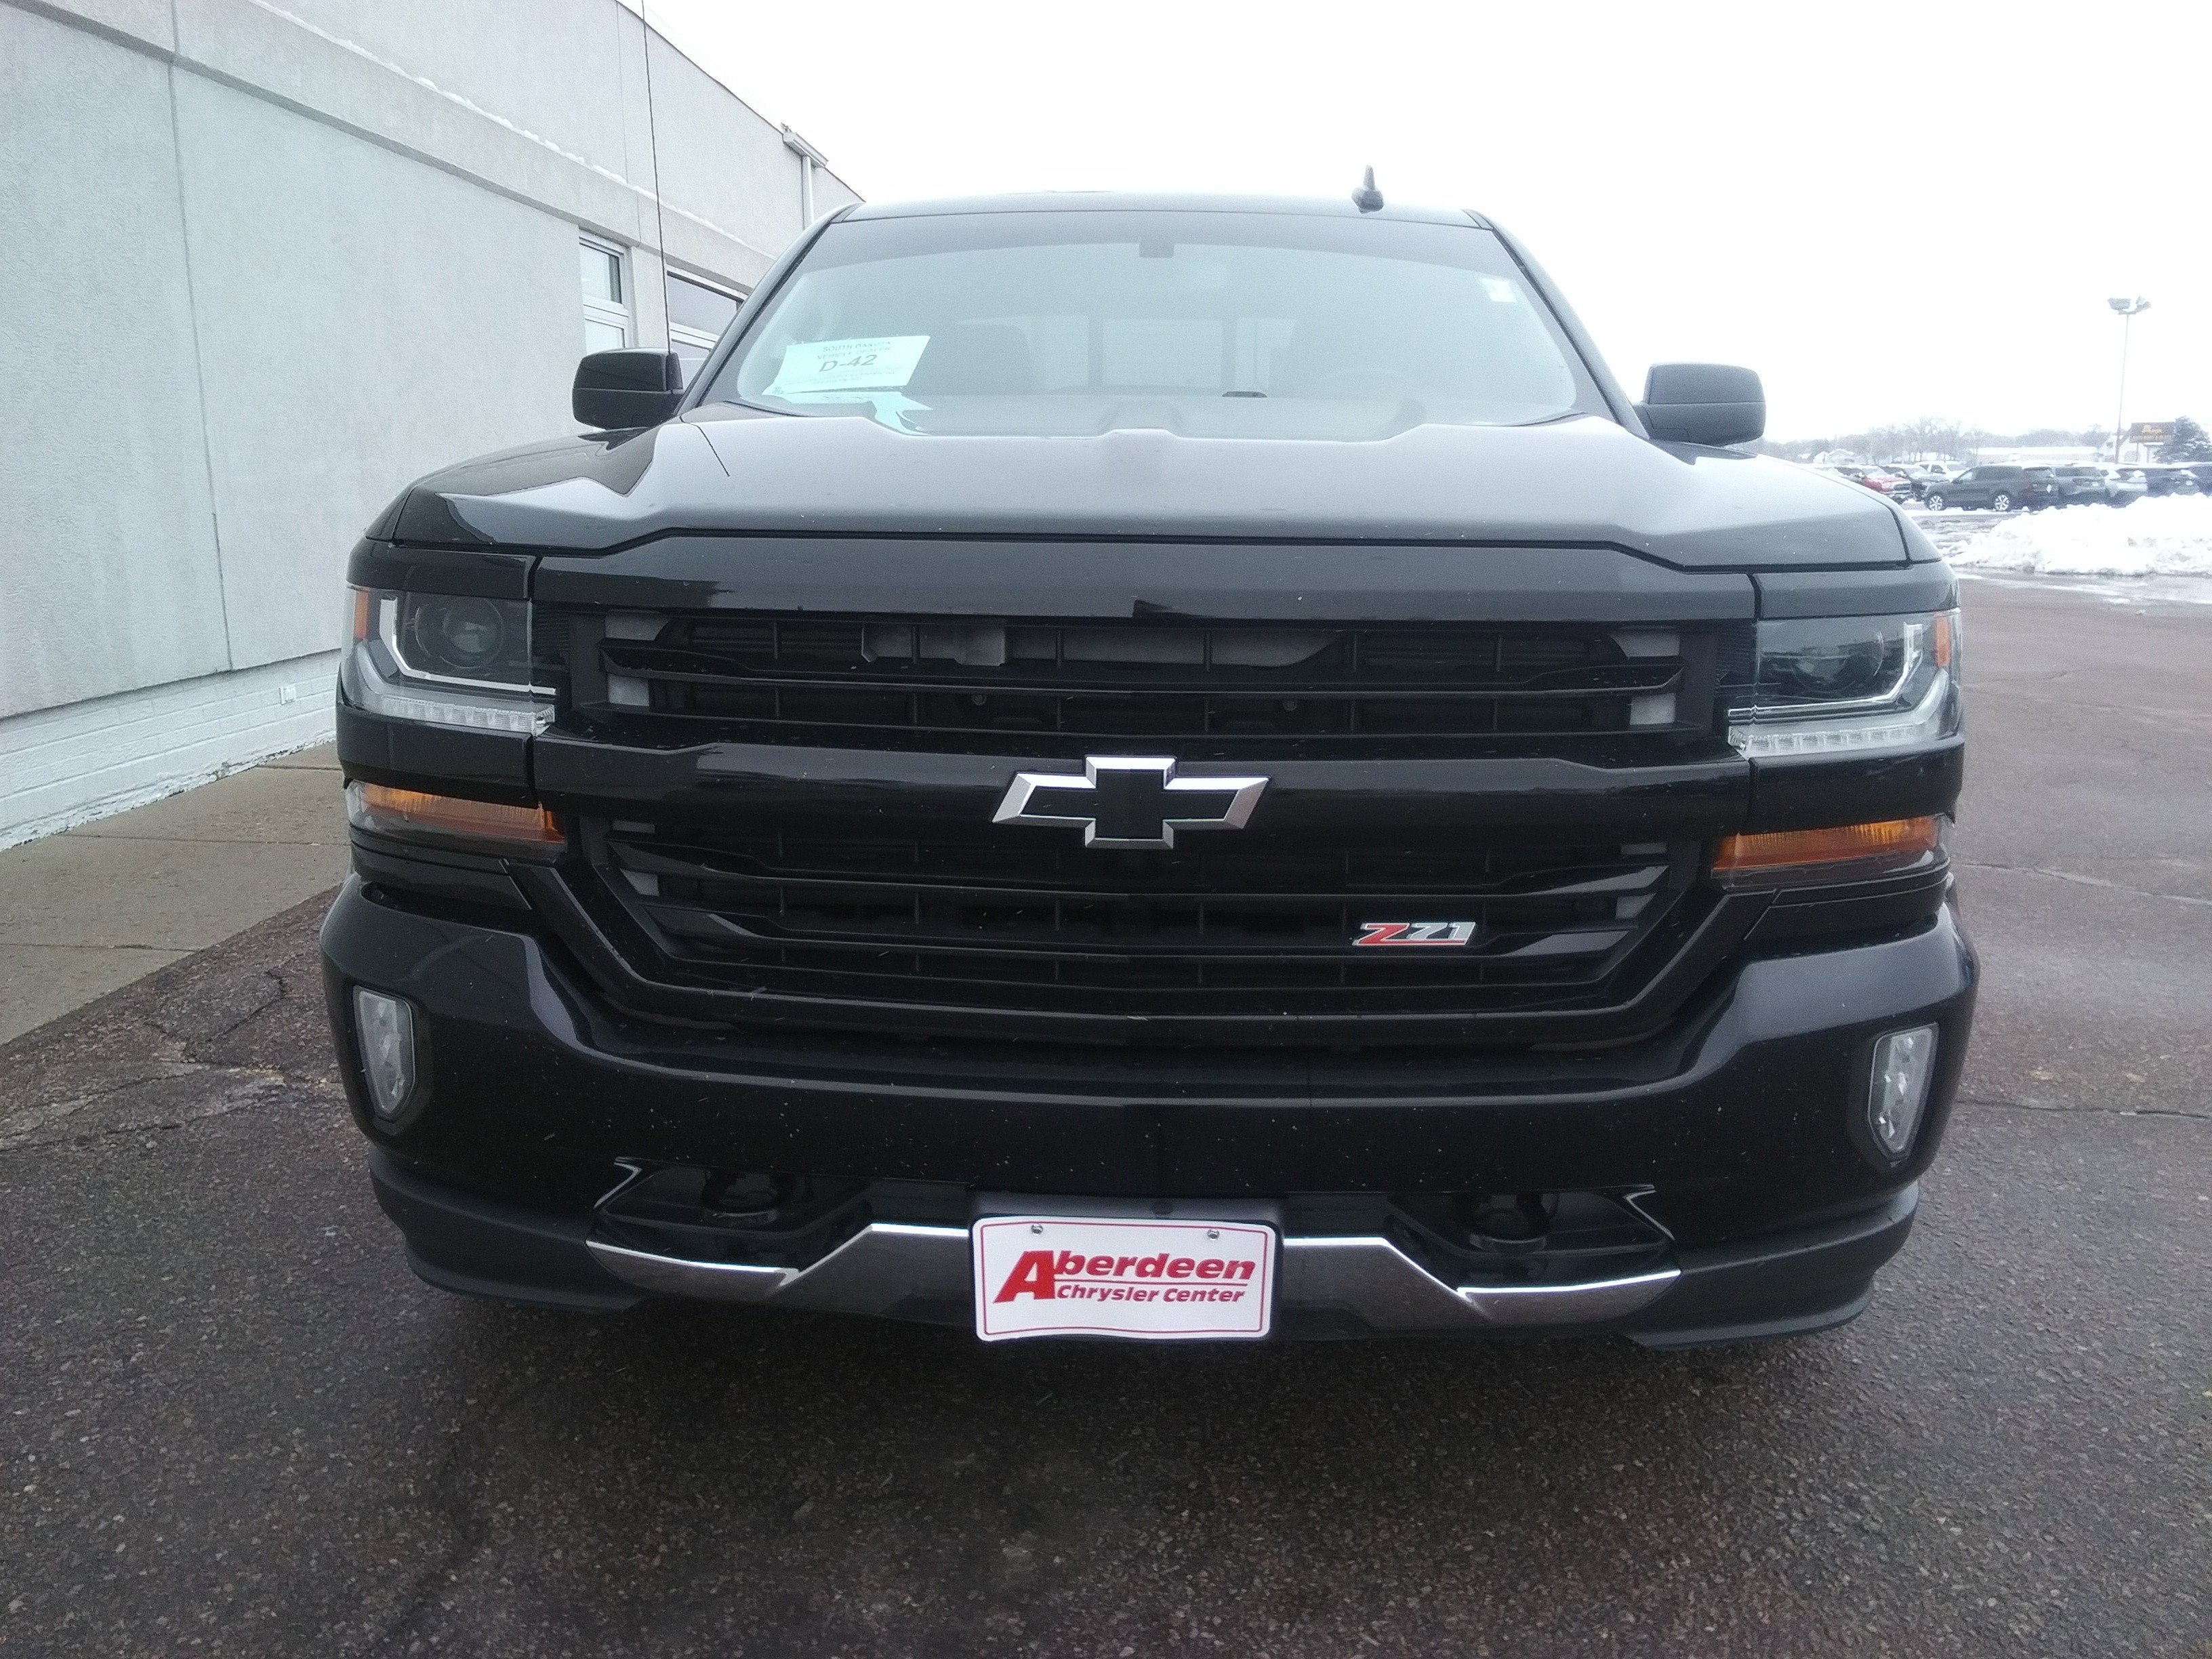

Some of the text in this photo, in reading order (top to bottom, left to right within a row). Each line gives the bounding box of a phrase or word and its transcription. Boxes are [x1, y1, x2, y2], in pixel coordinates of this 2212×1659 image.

[819, 354, 878, 372] D-42
[1352, 922, 1476, 945] Z71
[993, 1250, 1256, 1303] Aberdeen
[1056, 1284, 1245, 1303] Chrysler Center
